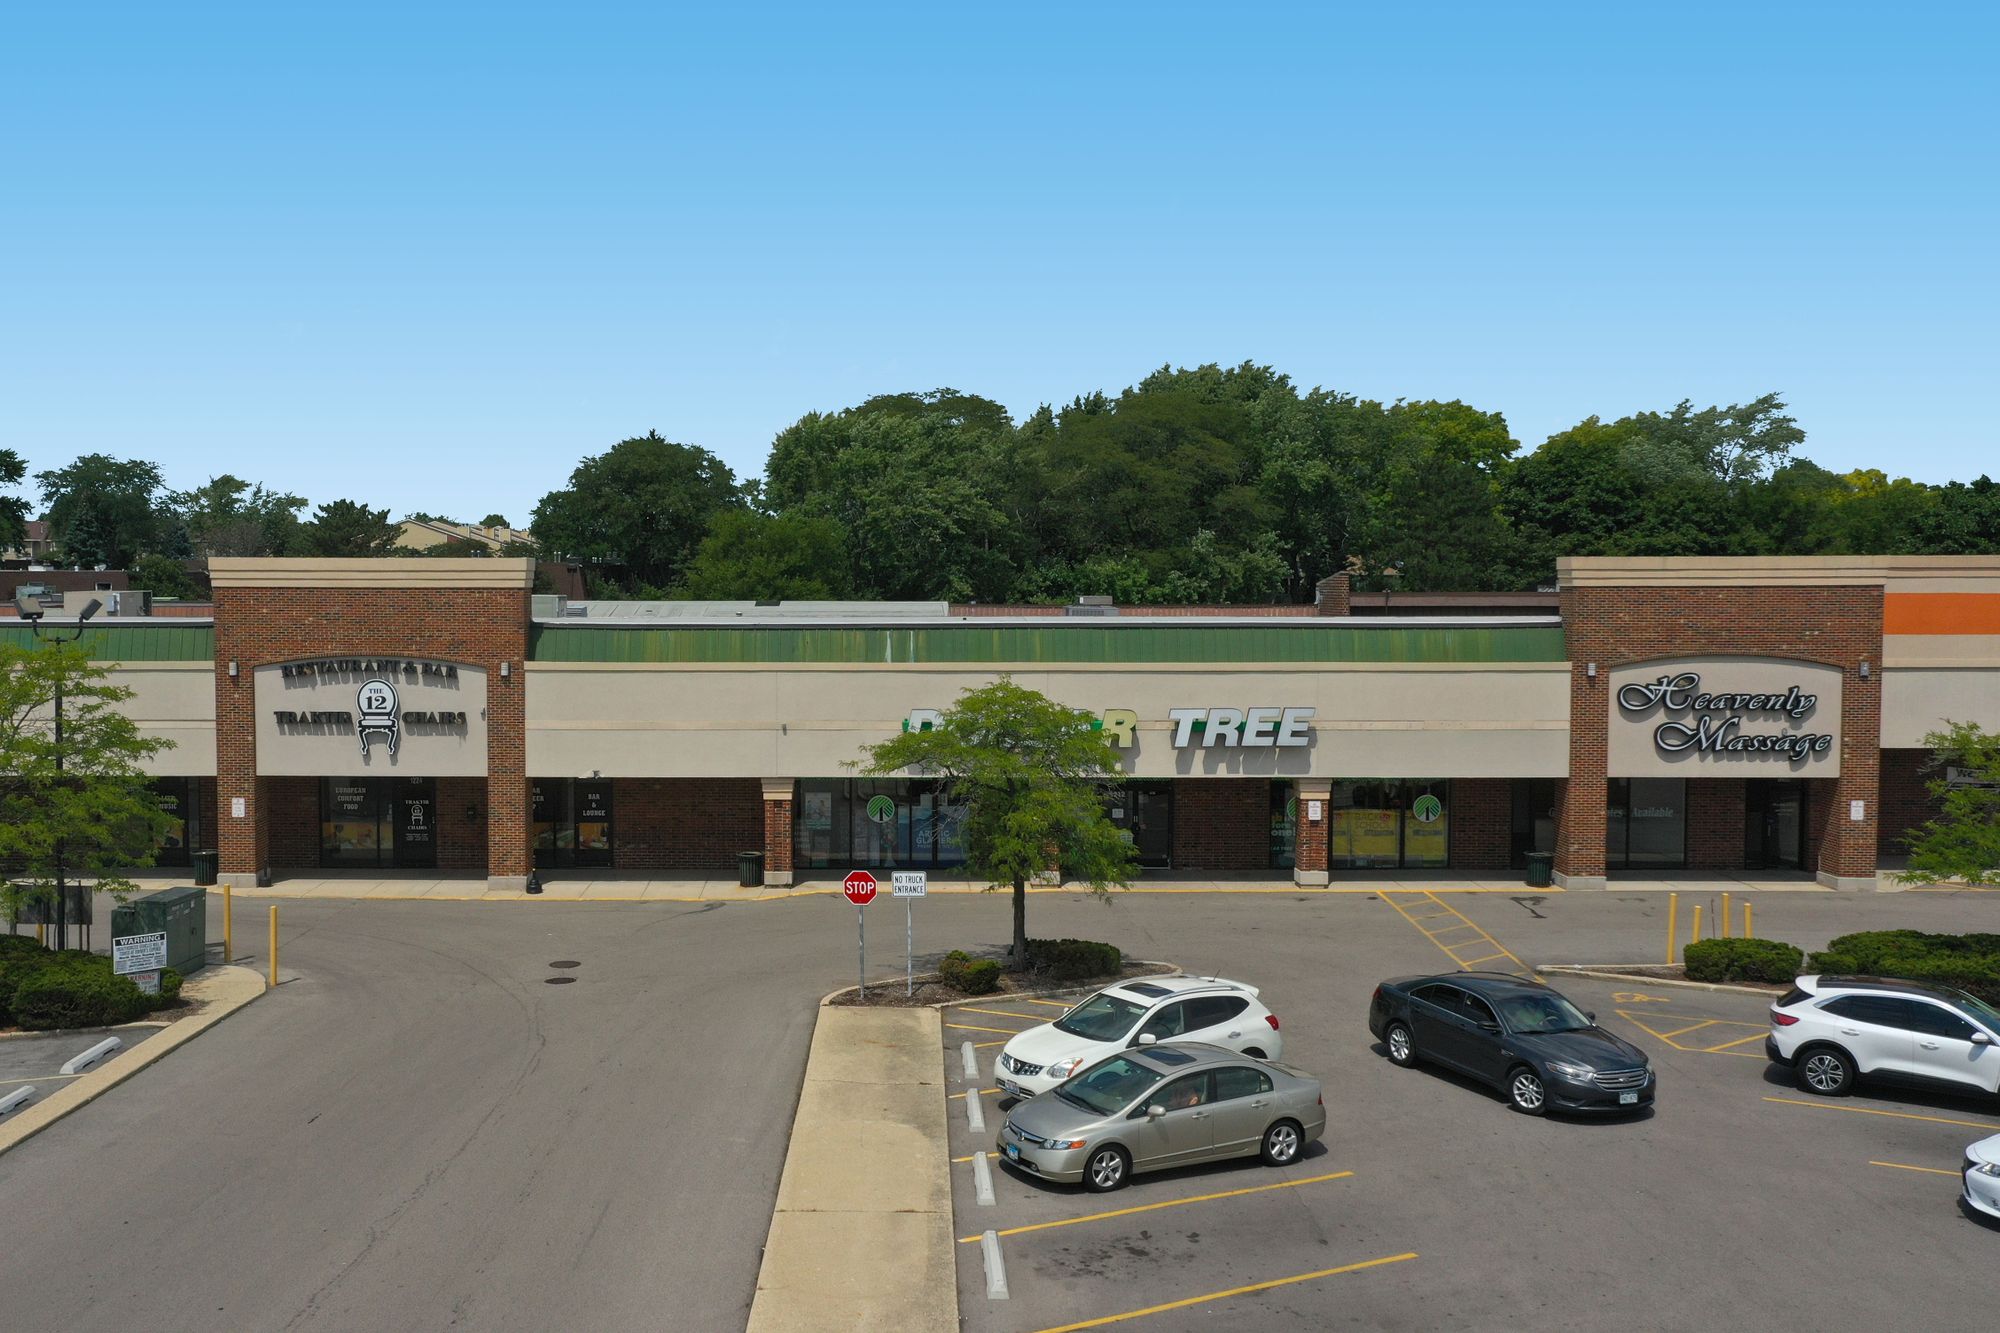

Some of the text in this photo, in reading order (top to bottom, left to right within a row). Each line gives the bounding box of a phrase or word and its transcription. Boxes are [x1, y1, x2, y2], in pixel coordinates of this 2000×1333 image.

[281, 659, 459, 679] RESTAURANT & BAR
[1617, 672, 1818, 718] Heavenly
[365, 695, 387, 710] 12
[274, 711, 353, 725] TRAKTIR
[402, 711, 467, 726] CHAIRS
[1168, 706, 1317, 748] TREE
[1654, 715, 1833, 762] Massage
[1632, 807, 1674, 817] Available
[894, 875, 923, 884] NO TRUCK
[846, 881, 875, 895] STOP
[894, 885, 924, 894] ENTRANCE
[120, 934, 161, 946] WARNING
